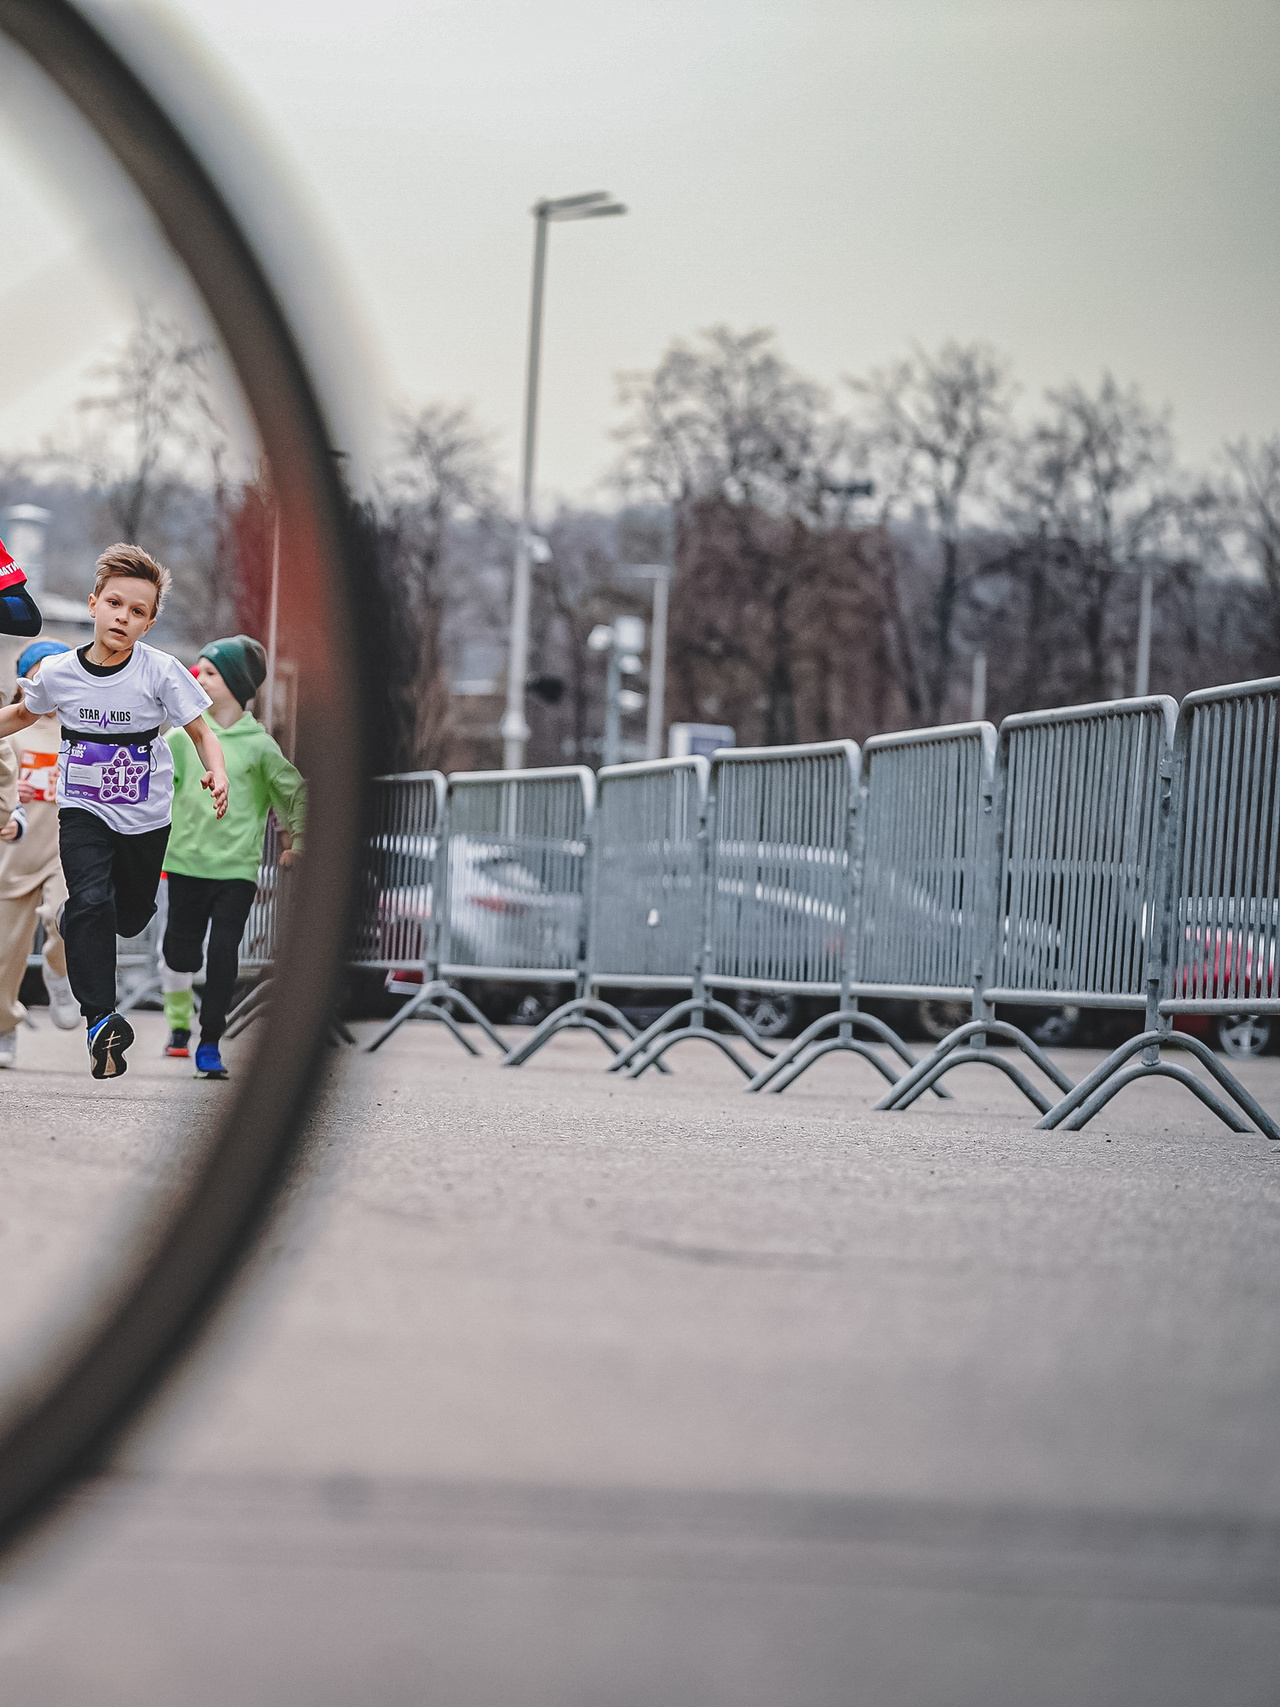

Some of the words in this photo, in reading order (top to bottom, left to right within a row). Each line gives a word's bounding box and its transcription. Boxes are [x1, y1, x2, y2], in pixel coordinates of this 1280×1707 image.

[79, 708, 100, 720] STAR
[110, 711, 131, 722] KIDS
[114, 765, 126, 787] 1
